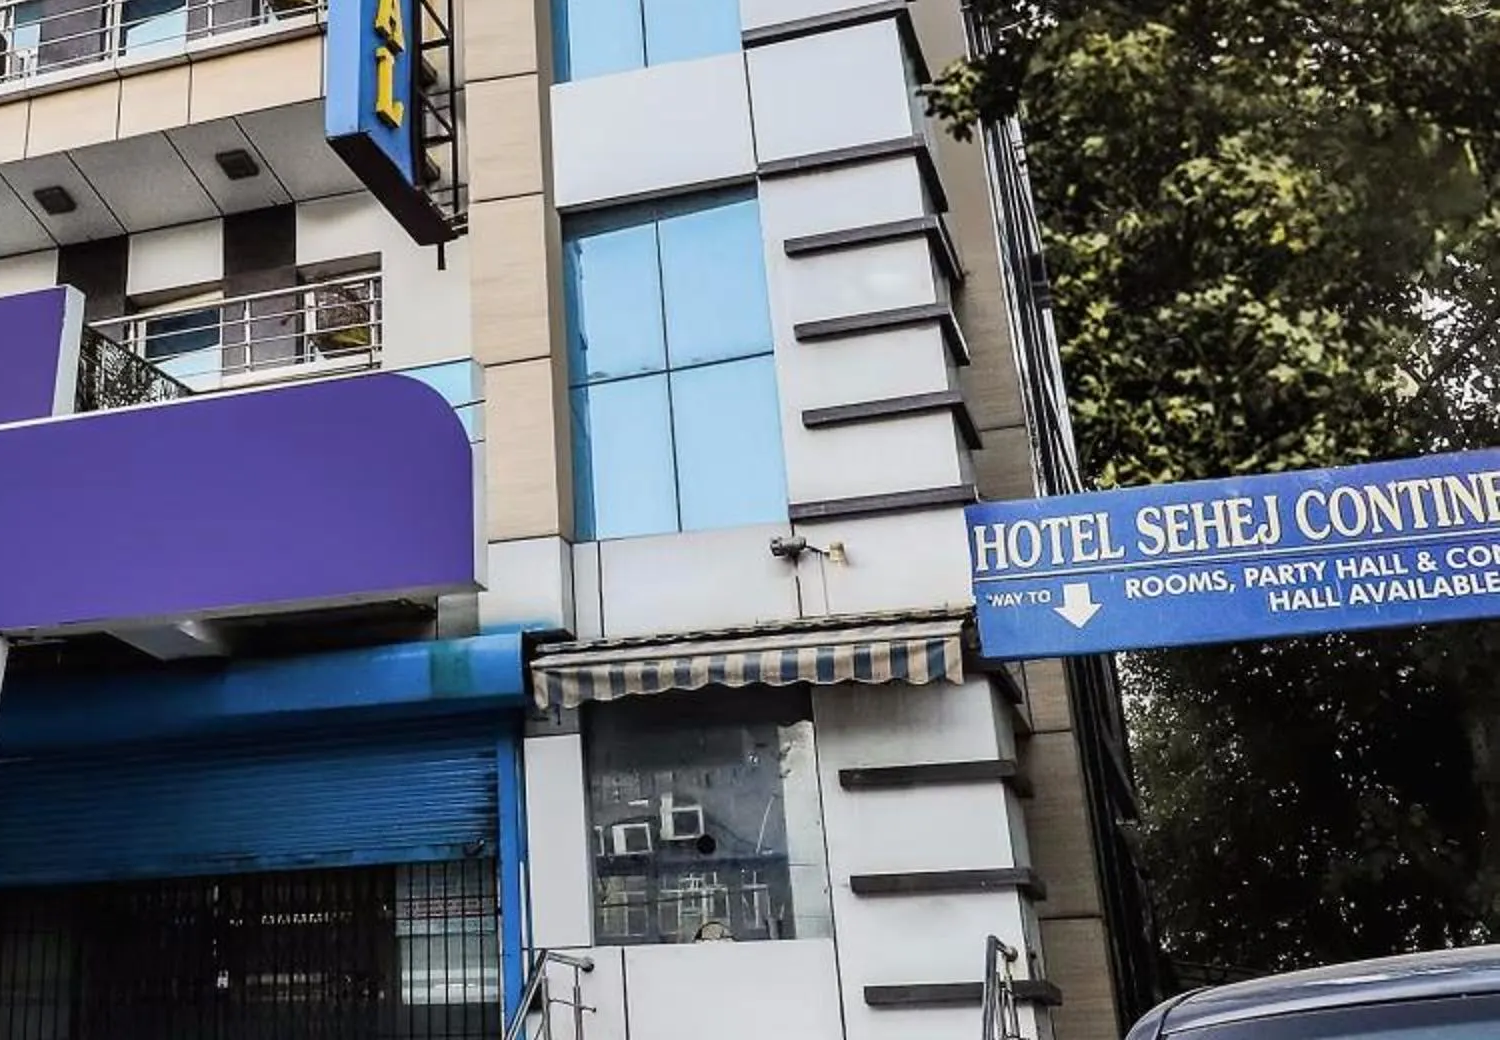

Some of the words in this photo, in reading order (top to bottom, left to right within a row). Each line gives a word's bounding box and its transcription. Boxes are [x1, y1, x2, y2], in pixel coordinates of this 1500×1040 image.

[974, 512, 1125, 572] HOTEL
[1136, 494, 1281, 557] SEHEJ
[1026, 589, 1052, 605] TO
[1125, 570, 1236, 599] ROOMS,
[1243, 561, 1326, 588] PARTY
[1336, 553, 1408, 580] HALL
[1417, 551, 1439, 573] &
[1269, 585, 1341, 612] HALL
[1349, 571, 1500, 605] AVAILABLE
